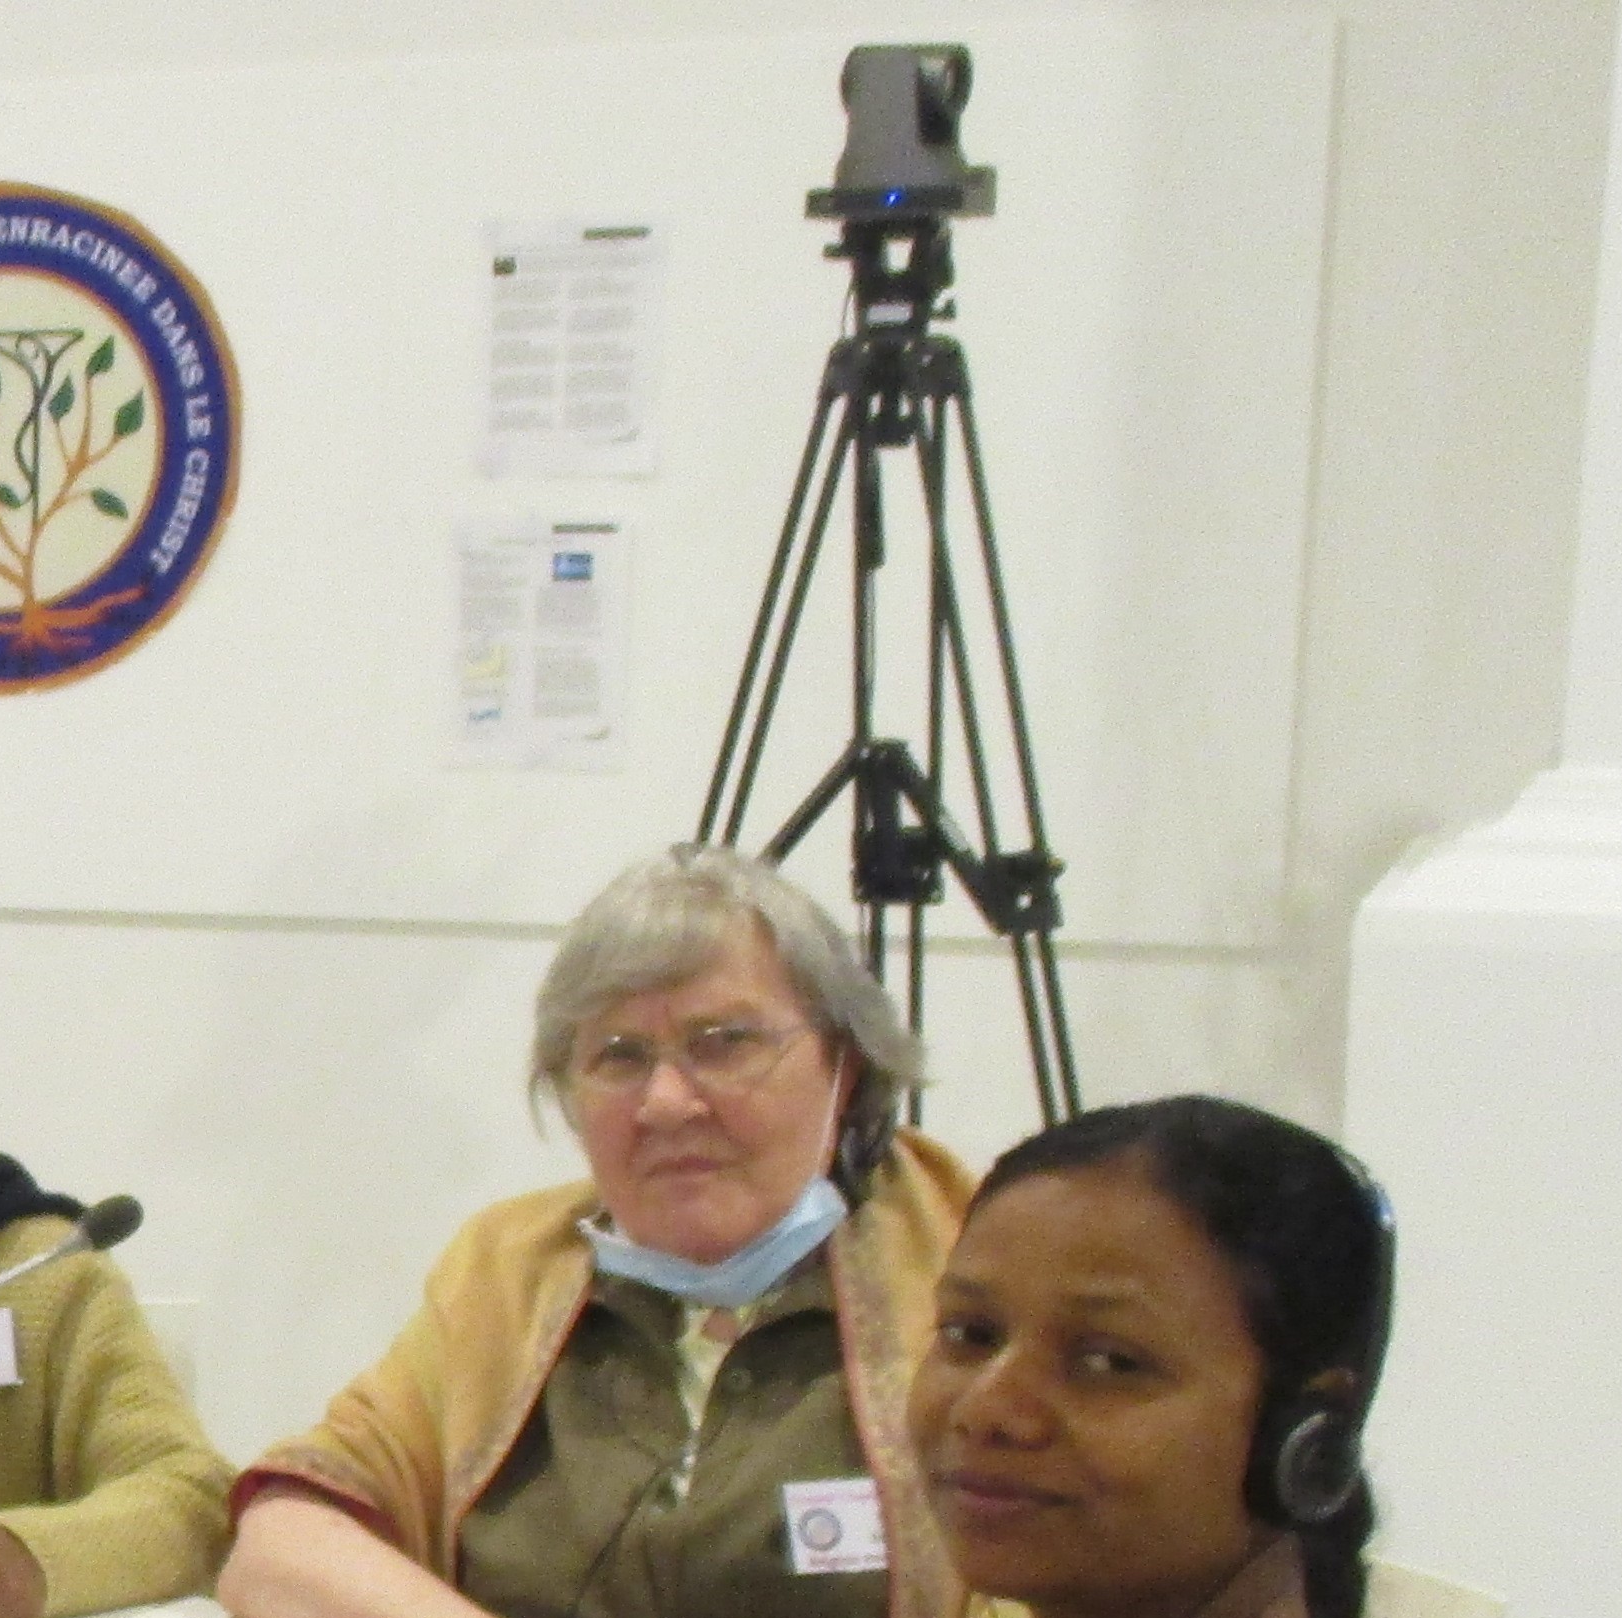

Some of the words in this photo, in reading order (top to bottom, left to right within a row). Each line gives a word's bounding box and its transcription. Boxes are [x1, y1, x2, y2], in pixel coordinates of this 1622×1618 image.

[151, 297, 205, 390] DANS
[186, 392, 212, 440] LE
[149, 447, 210, 576] CHRIST
